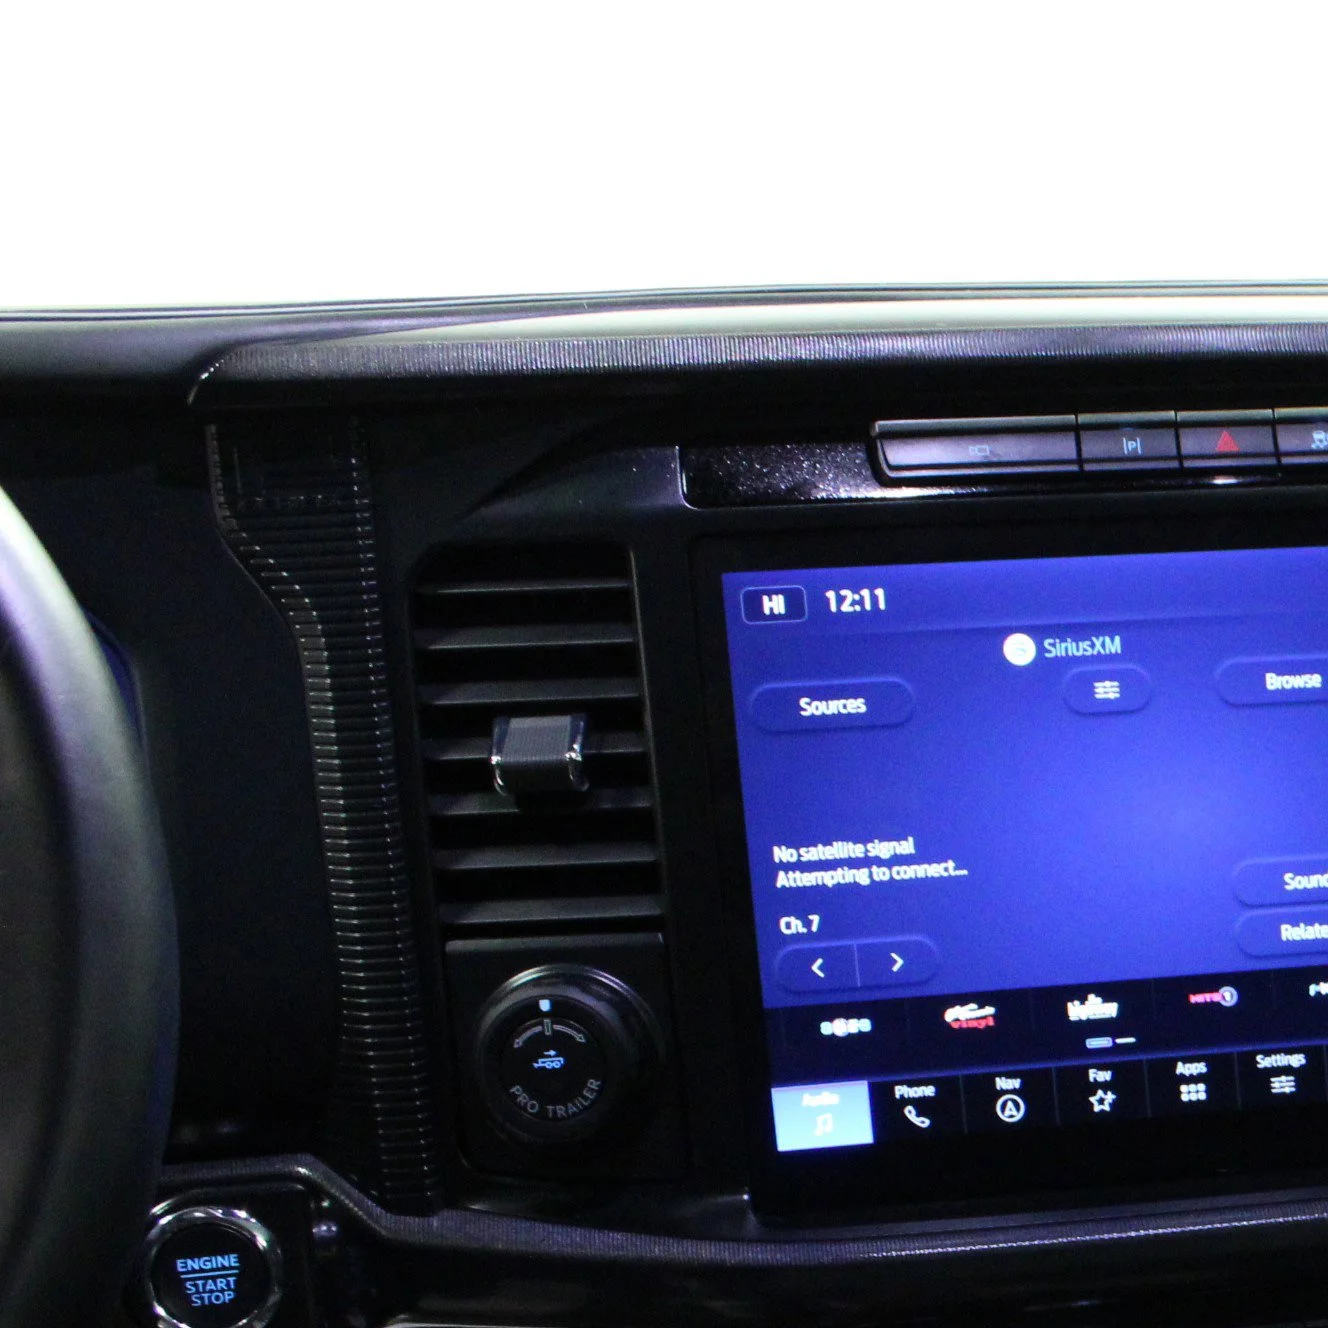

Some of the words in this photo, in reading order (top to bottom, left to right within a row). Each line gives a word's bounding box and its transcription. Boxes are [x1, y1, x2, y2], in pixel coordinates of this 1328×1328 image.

[762, 594, 786, 615] HI
[824, 587, 887, 613] 12:11
[1043, 635, 1121, 658] SiriusXM
[1265, 671, 1322, 691] Browse
[799, 696, 867, 717] Sources
[773, 845, 798, 863] No
[800, 839, 865, 861] satellite
[866, 837, 915, 859] signal
[776, 866, 870, 889] Attempting
[871, 866, 890, 882] to
[779, 916, 806, 935] Ch.
[808, 915, 820, 933] 7
[1175, 1060, 1208, 1077] Apps
[1255, 1052, 1307, 1069] Settings
[995, 1076, 1022, 1091] Nav
[1088, 1068, 1112, 1083] Fav
[509, 1084, 539, 1113] PRO
[546, 1079, 601, 1119] TRAILER
[894, 1080, 936, 1099] Phone
[176, 1253, 240, 1272] ENGINE
[185, 1276, 237, 1294] START
[191, 1291, 234, 1307] STOP
